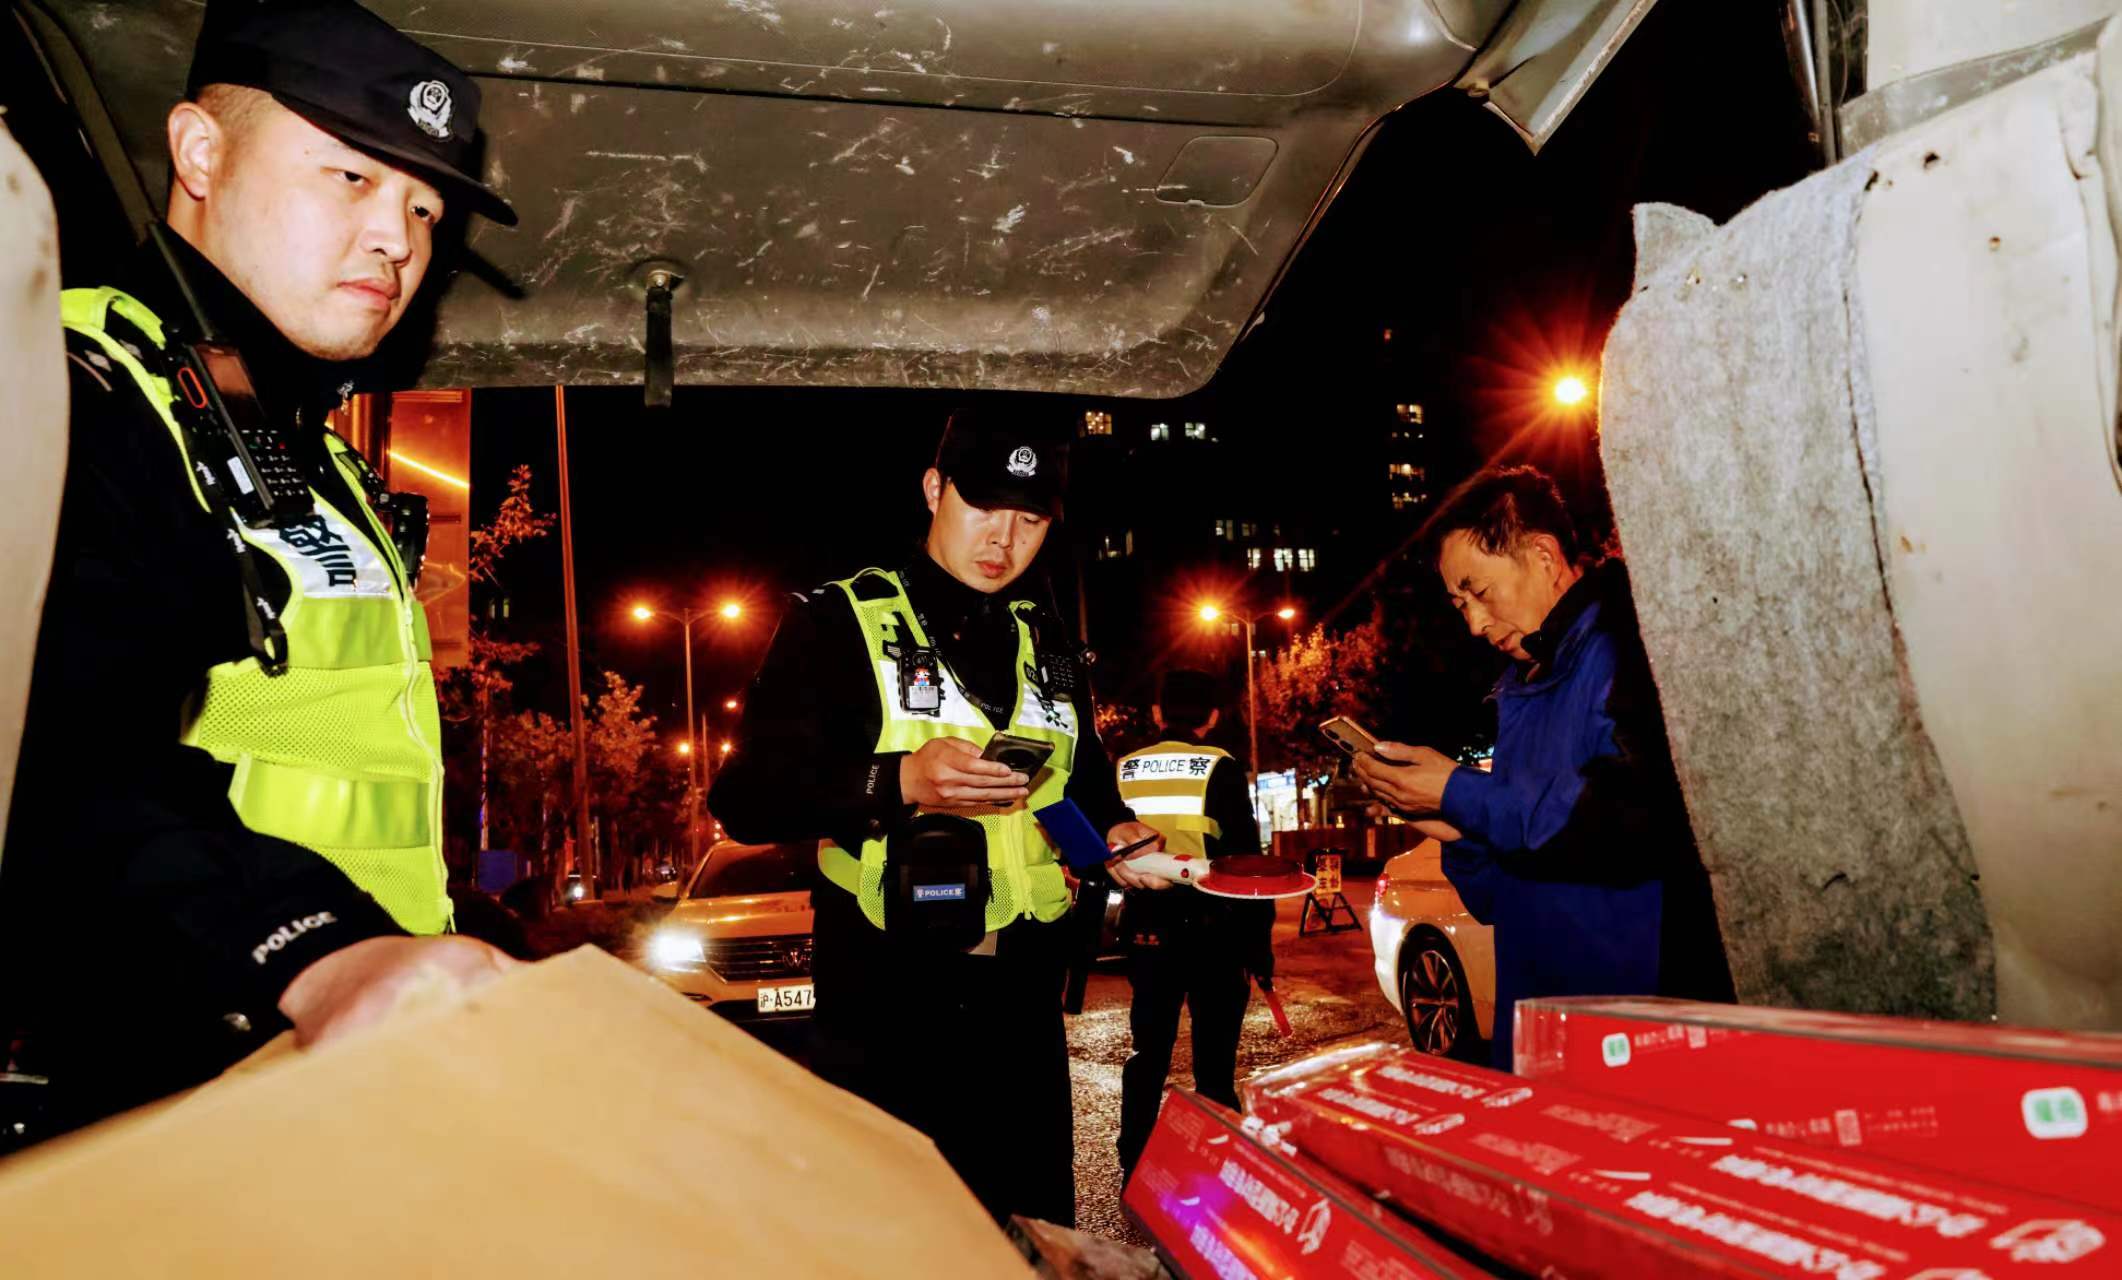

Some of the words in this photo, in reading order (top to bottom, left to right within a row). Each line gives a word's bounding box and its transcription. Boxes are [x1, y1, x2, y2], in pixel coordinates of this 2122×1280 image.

[866, 763, 880, 795] POLICE
[1121, 759, 1140, 779] 警
[1142, 760, 1185, 773] POLICE
[1189, 757, 1210, 775] 察
[925, 889, 953, 897] POLICE
[252, 911, 338, 965] POLICE
